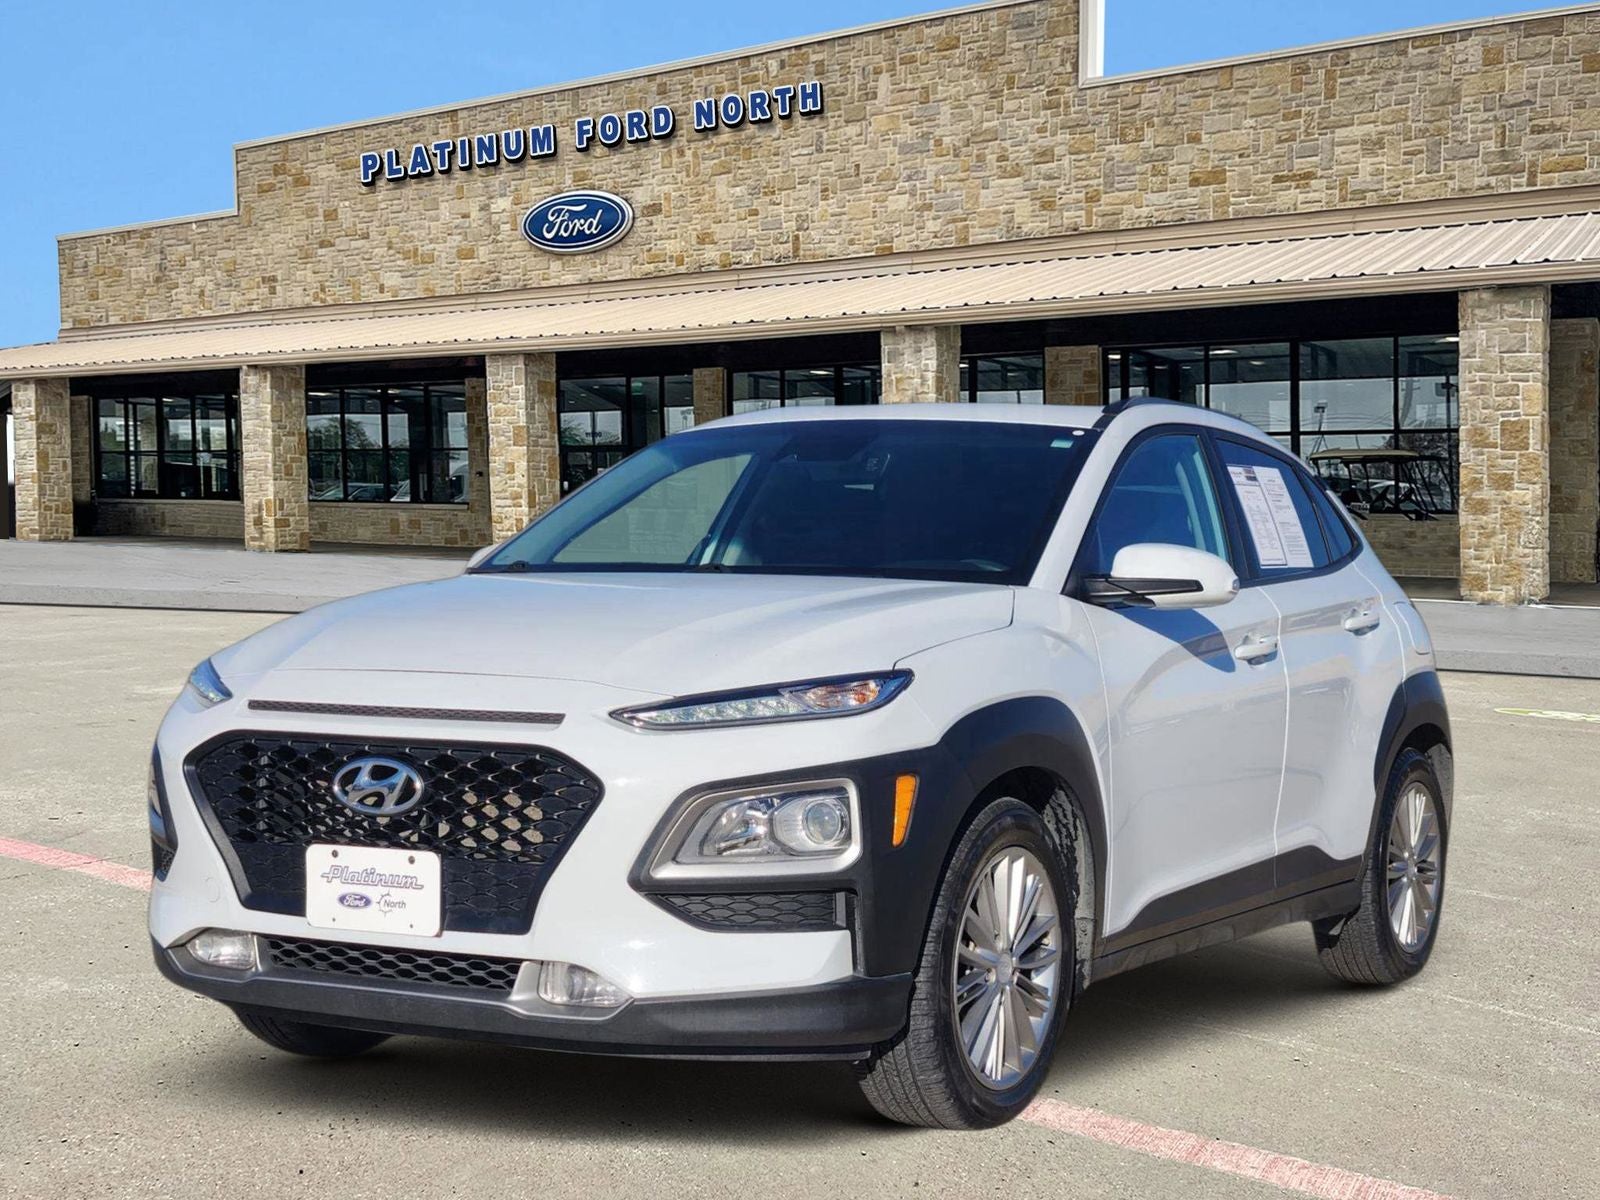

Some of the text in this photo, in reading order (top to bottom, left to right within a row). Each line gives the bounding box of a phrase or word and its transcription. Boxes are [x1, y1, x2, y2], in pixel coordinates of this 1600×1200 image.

[360, 80, 822, 186] PLATINUM FORD NORTH
[542, 203, 603, 239] Ford
[321, 864, 424, 890] Platinum
[343, 893, 407, 910] Ford North
